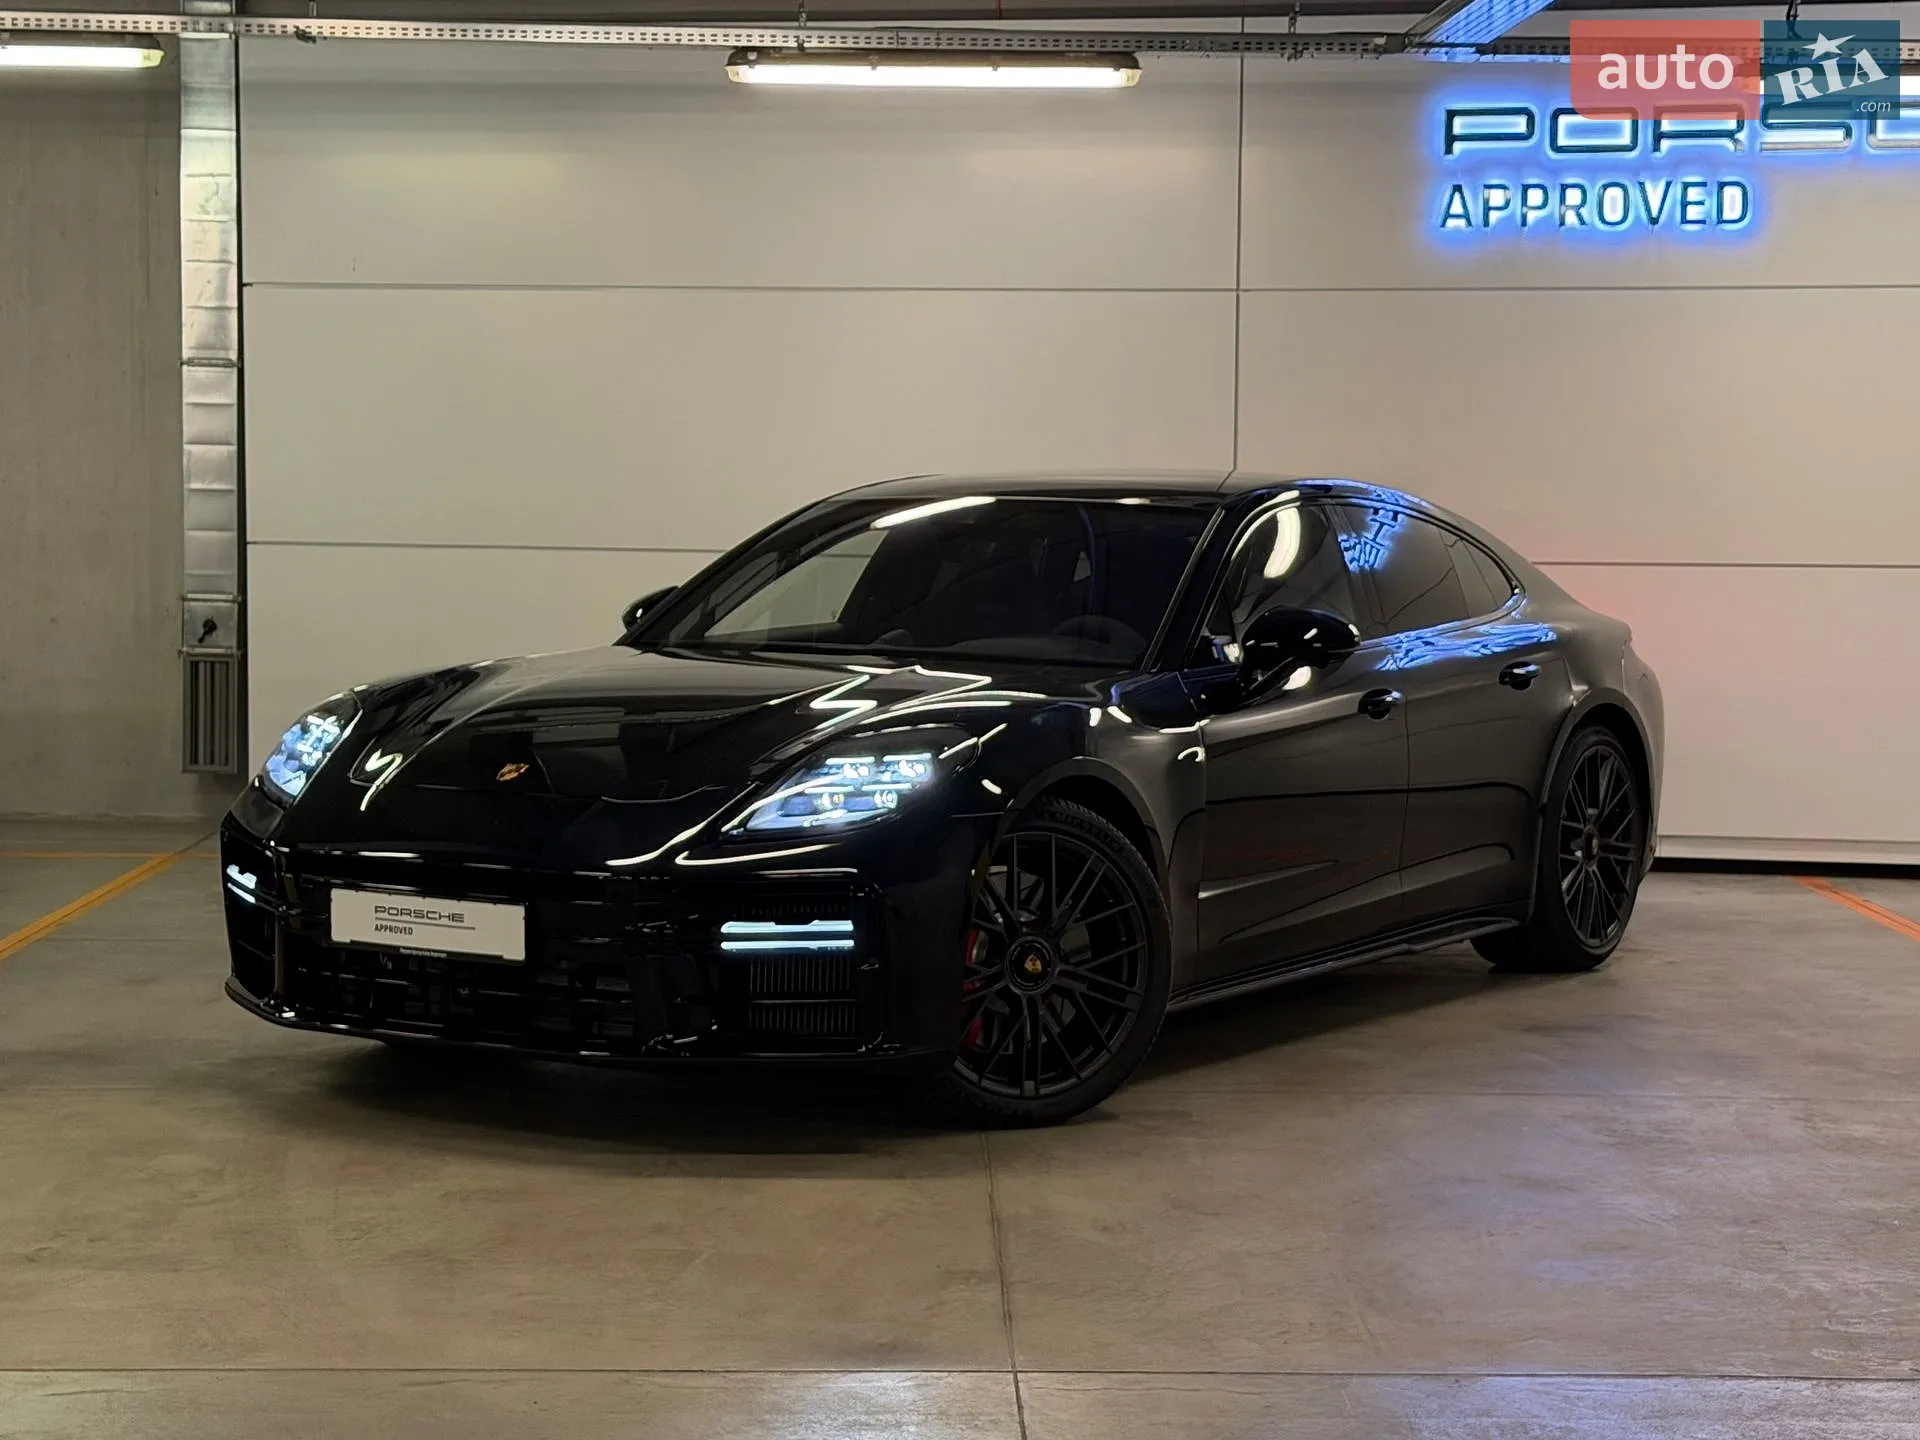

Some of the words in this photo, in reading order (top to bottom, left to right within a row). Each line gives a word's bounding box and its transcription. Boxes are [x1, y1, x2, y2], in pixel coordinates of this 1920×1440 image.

[1440, 180, 1749, 229] APPROVED
[374, 905, 464, 922] PORSCHE
[374, 924, 413, 936] APPROVED
